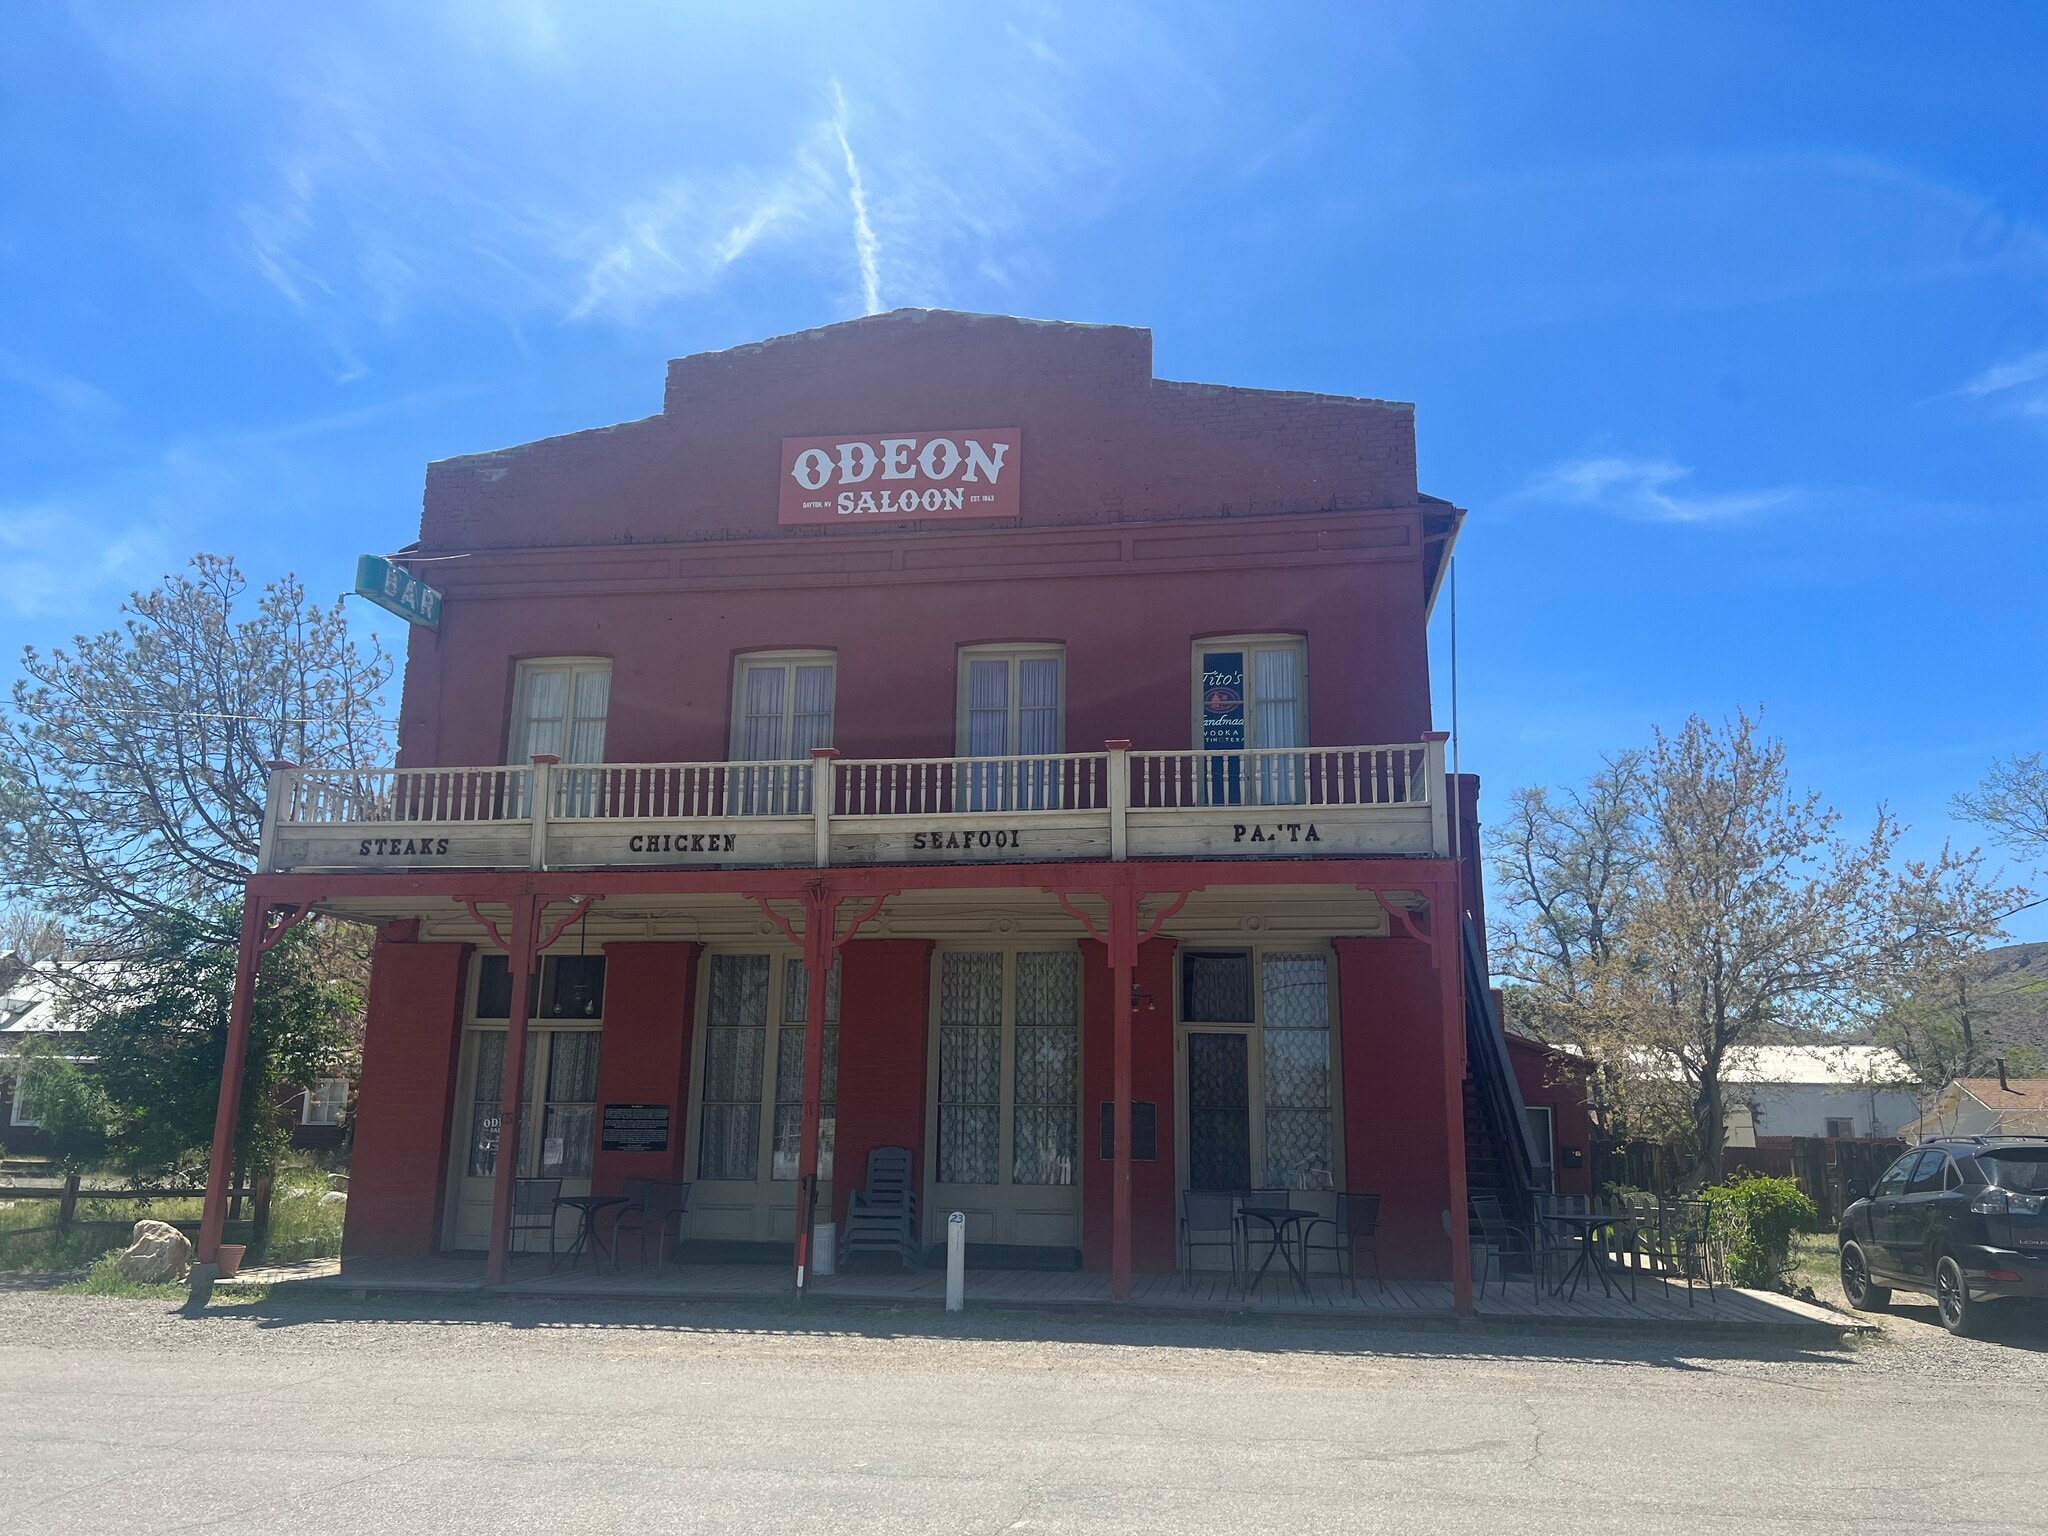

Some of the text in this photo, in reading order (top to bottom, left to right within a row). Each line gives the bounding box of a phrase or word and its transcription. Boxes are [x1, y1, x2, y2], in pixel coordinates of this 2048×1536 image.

[791, 438, 1009, 490] ODEON
[837, 487, 965, 515] SALOON
[384, 566, 434, 619] BAR
[1202, 670, 1243, 686] Tito's
[359, 838, 449, 855] STEAKS
[629, 834, 736, 852] CHICKEN
[949, 1214, 964, 1223] 23
